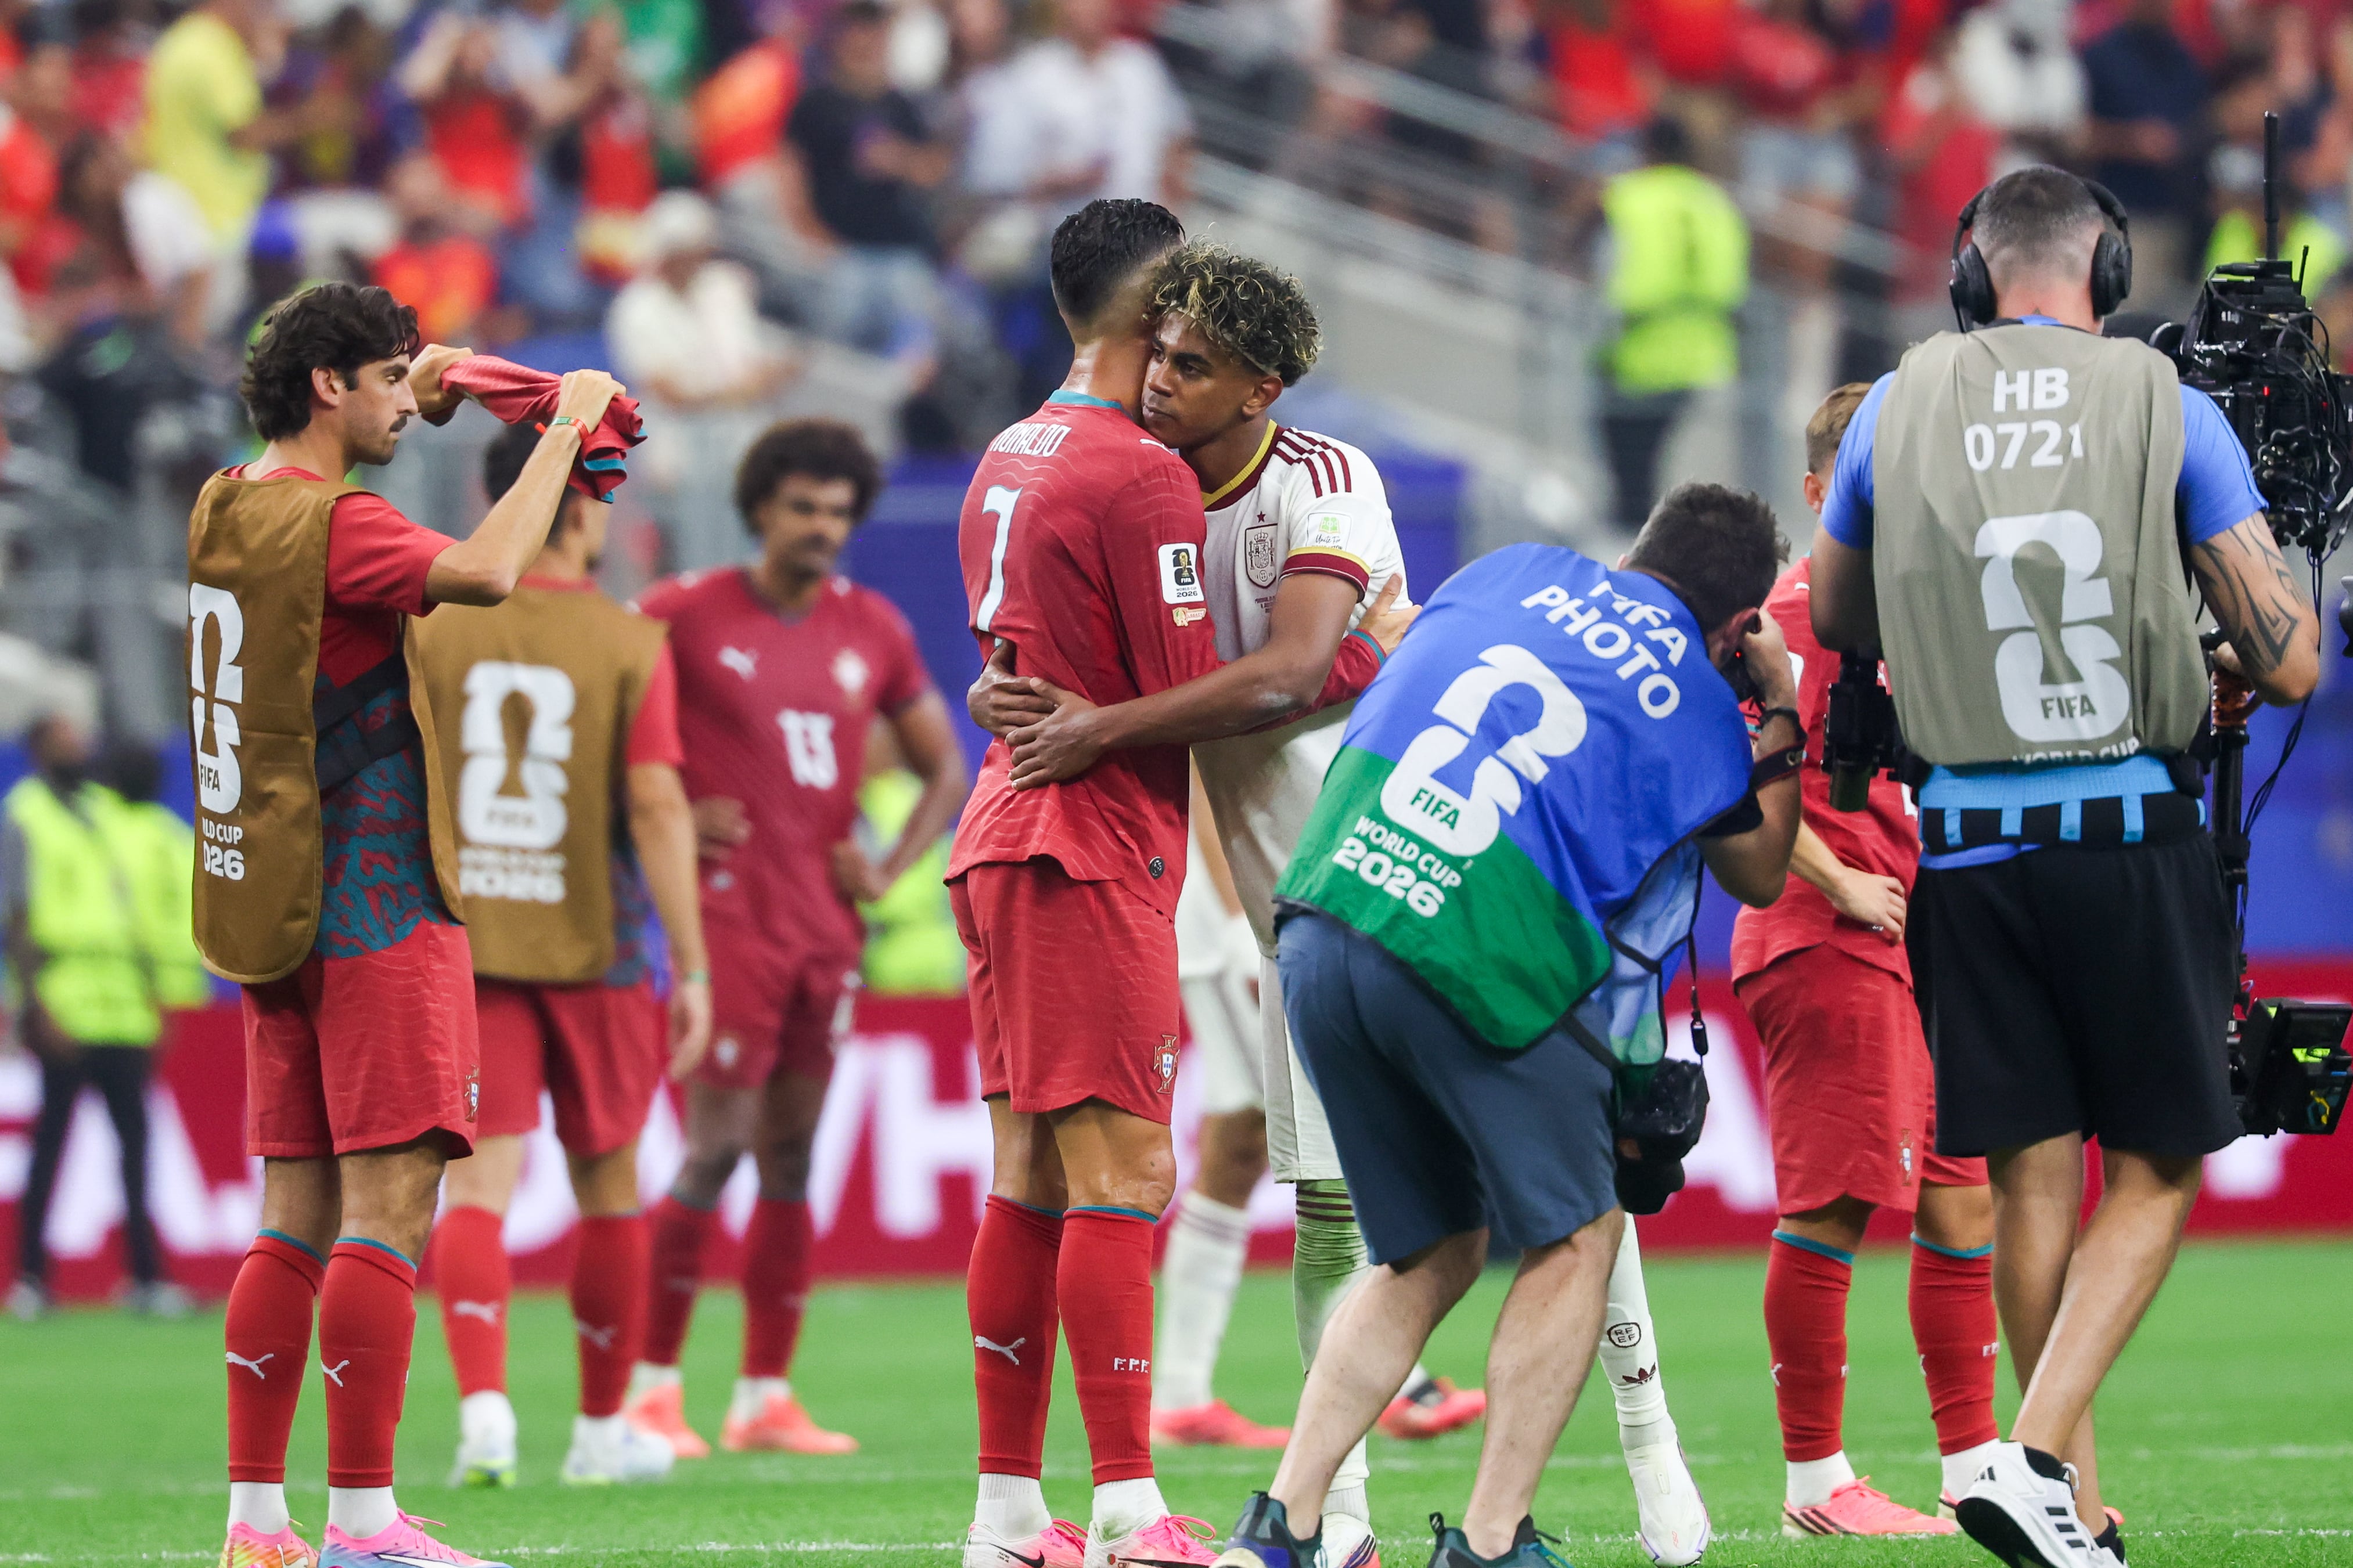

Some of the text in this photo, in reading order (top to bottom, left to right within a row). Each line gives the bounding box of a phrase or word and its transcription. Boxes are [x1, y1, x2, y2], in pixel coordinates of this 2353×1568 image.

[1993, 367, 2070, 412] HB
[989, 423, 1072, 457] RONALDO
[1964, 420, 2084, 471] 0721
[977, 485, 1023, 648] 7
[1520, 585, 1681, 719] PHOTO
[2040, 697, 2098, 720] FIFA
[200, 763, 221, 792] FIFA
[1409, 787, 1460, 831] FIFA
[216, 823, 243, 845] CUP
[1354, 815, 1462, 888] WORLD CUP
[203, 840, 244, 881] 026
[1332, 837, 1446, 918] 2026
